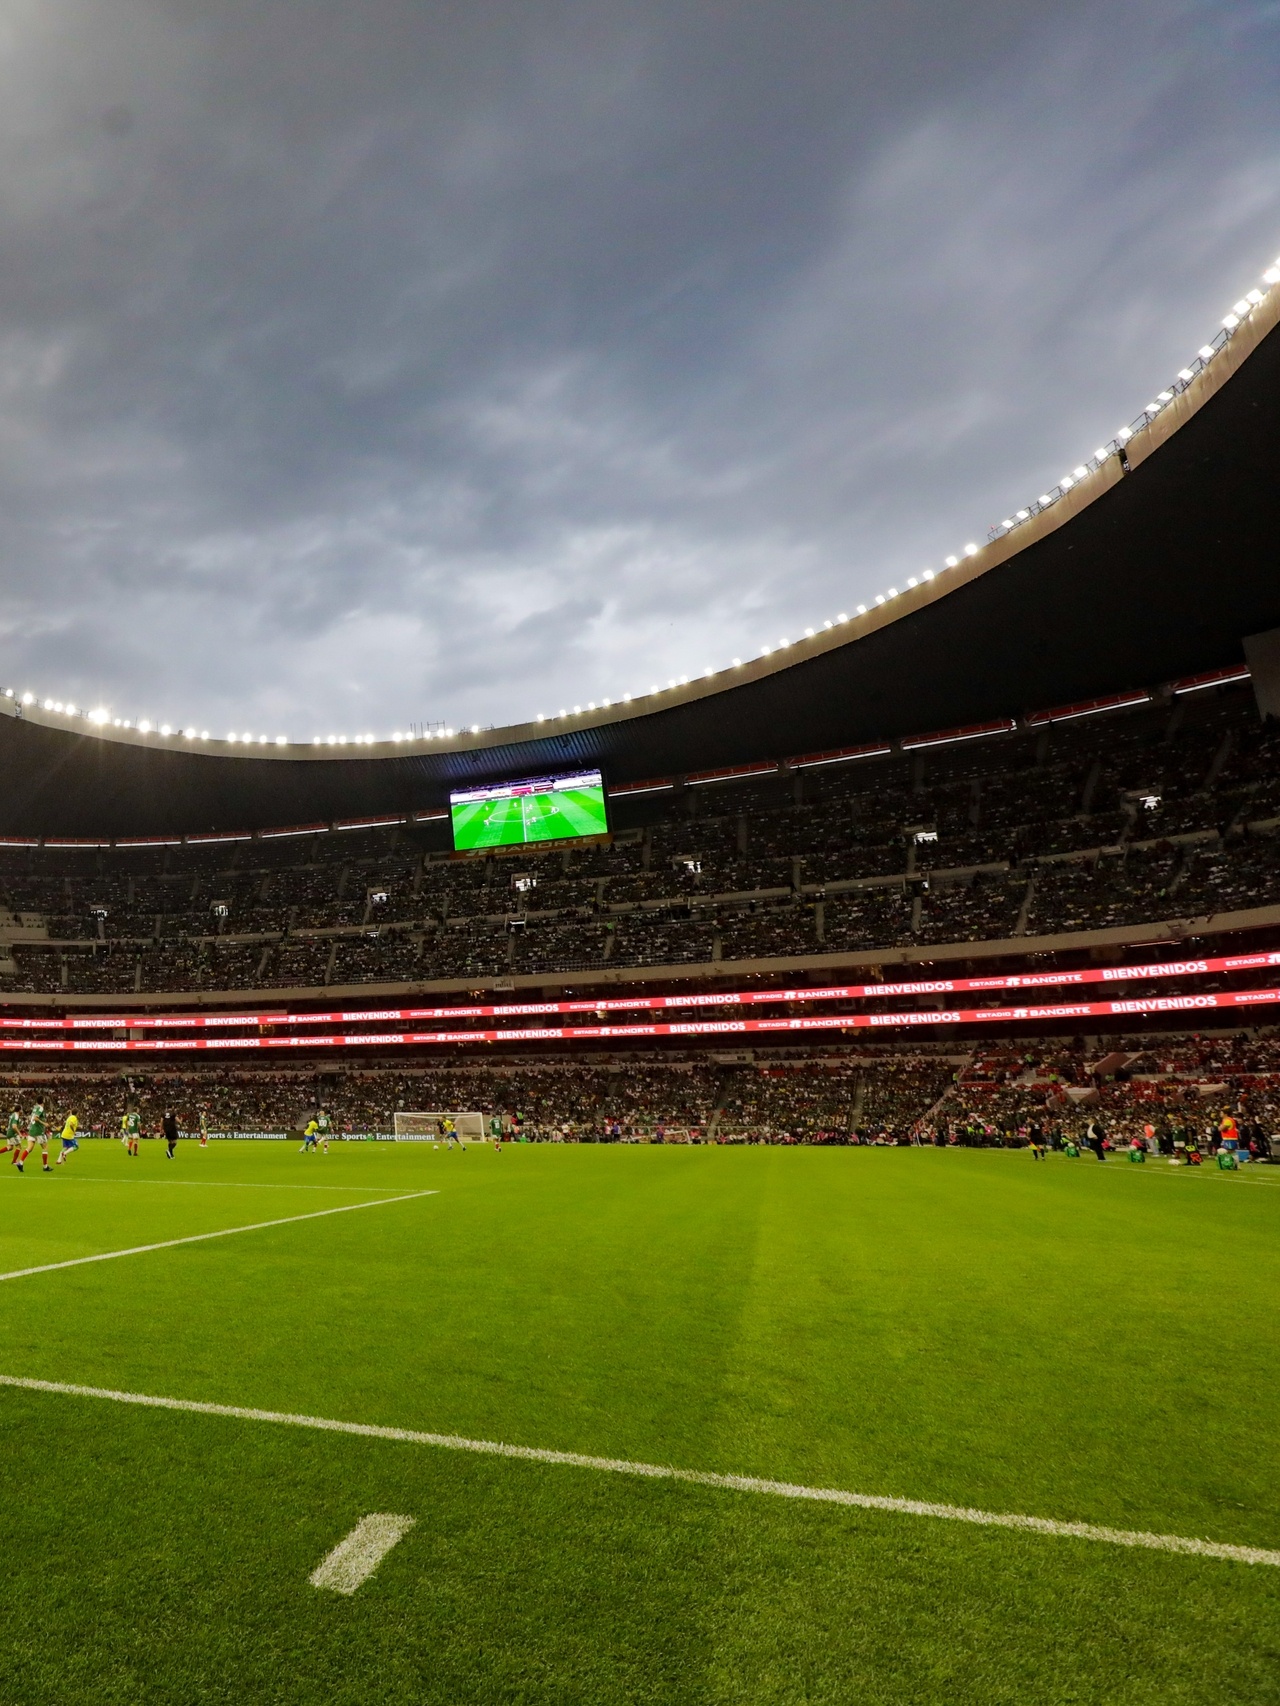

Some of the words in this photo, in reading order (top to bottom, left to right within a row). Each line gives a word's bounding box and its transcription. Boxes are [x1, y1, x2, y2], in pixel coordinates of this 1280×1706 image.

[494, 837, 596, 853] BANORTE
[205, 1017, 258, 1025] BIENVENIDOS
[343, 1011, 401, 1020] BIENVENIDOS
[444, 1008, 482, 1016] BANORTE
[494, 1004, 559, 1014] BIENVENIDOS
[665, 994, 740, 1006] BIENVENIDOS
[798, 990, 848, 998] BANORTE
[864, 982, 953, 995] BIENVENIDOS
[1022, 974, 1082, 984] BANORTE
[1103, 961, 1207, 979] BIENVENIDOS
[1226, 958, 1266, 966] ESTADIO
[206, 1039, 260, 1047] BIENVENIDOS
[345, 1035, 404, 1044] BIENVENIDOS
[447, 1033, 485, 1041] BANORTE
[497, 1029, 562, 1039] BIENVENIDOS
[612, 1027, 655, 1035] BANORTE
[670, 1022, 745, 1033] BIENVENIDOS
[803, 1019, 854, 1027] BANORTE
[870, 1012, 960, 1025] BIENVENIDOS
[976, 1011, 1011, 1019] ESTADIO
[1030, 1007, 1090, 1016] BANORTE
[1111, 996, 1217, 1012] BIENVENIDOS
[1235, 993, 1275, 1001] ESTADIO
[206, 1132, 225, 1140] ports
[341, 1132, 367, 1140] Sports
